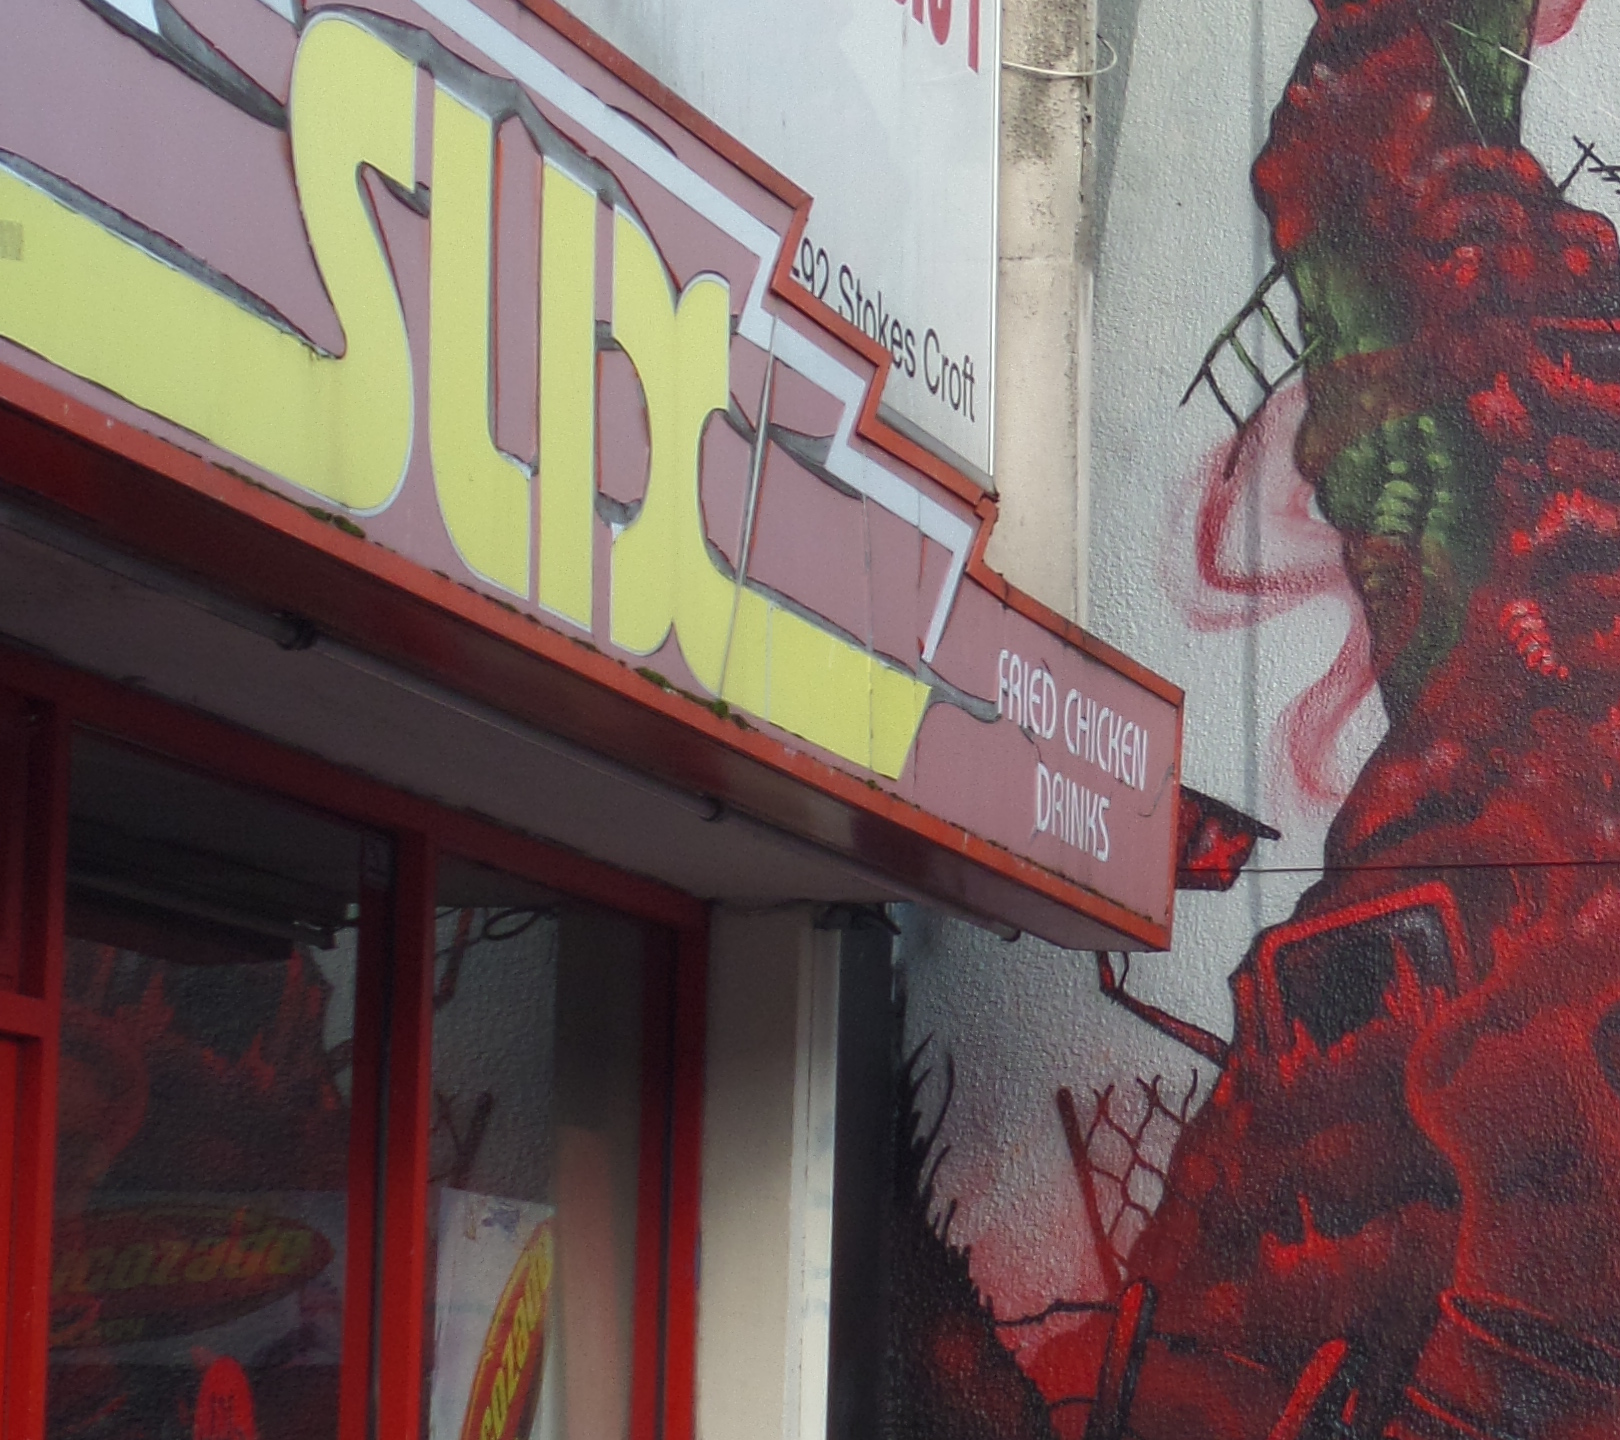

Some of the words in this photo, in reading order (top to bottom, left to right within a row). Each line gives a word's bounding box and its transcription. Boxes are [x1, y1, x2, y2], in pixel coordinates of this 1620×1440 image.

[839, 264, 916, 379] Stokes
[924, 328, 975, 423] Croft
[998, 648, 1058, 741] FRIED
[1064, 688, 1148, 791] CHICKEN
[1037, 761, 1111, 863] DRINKS
